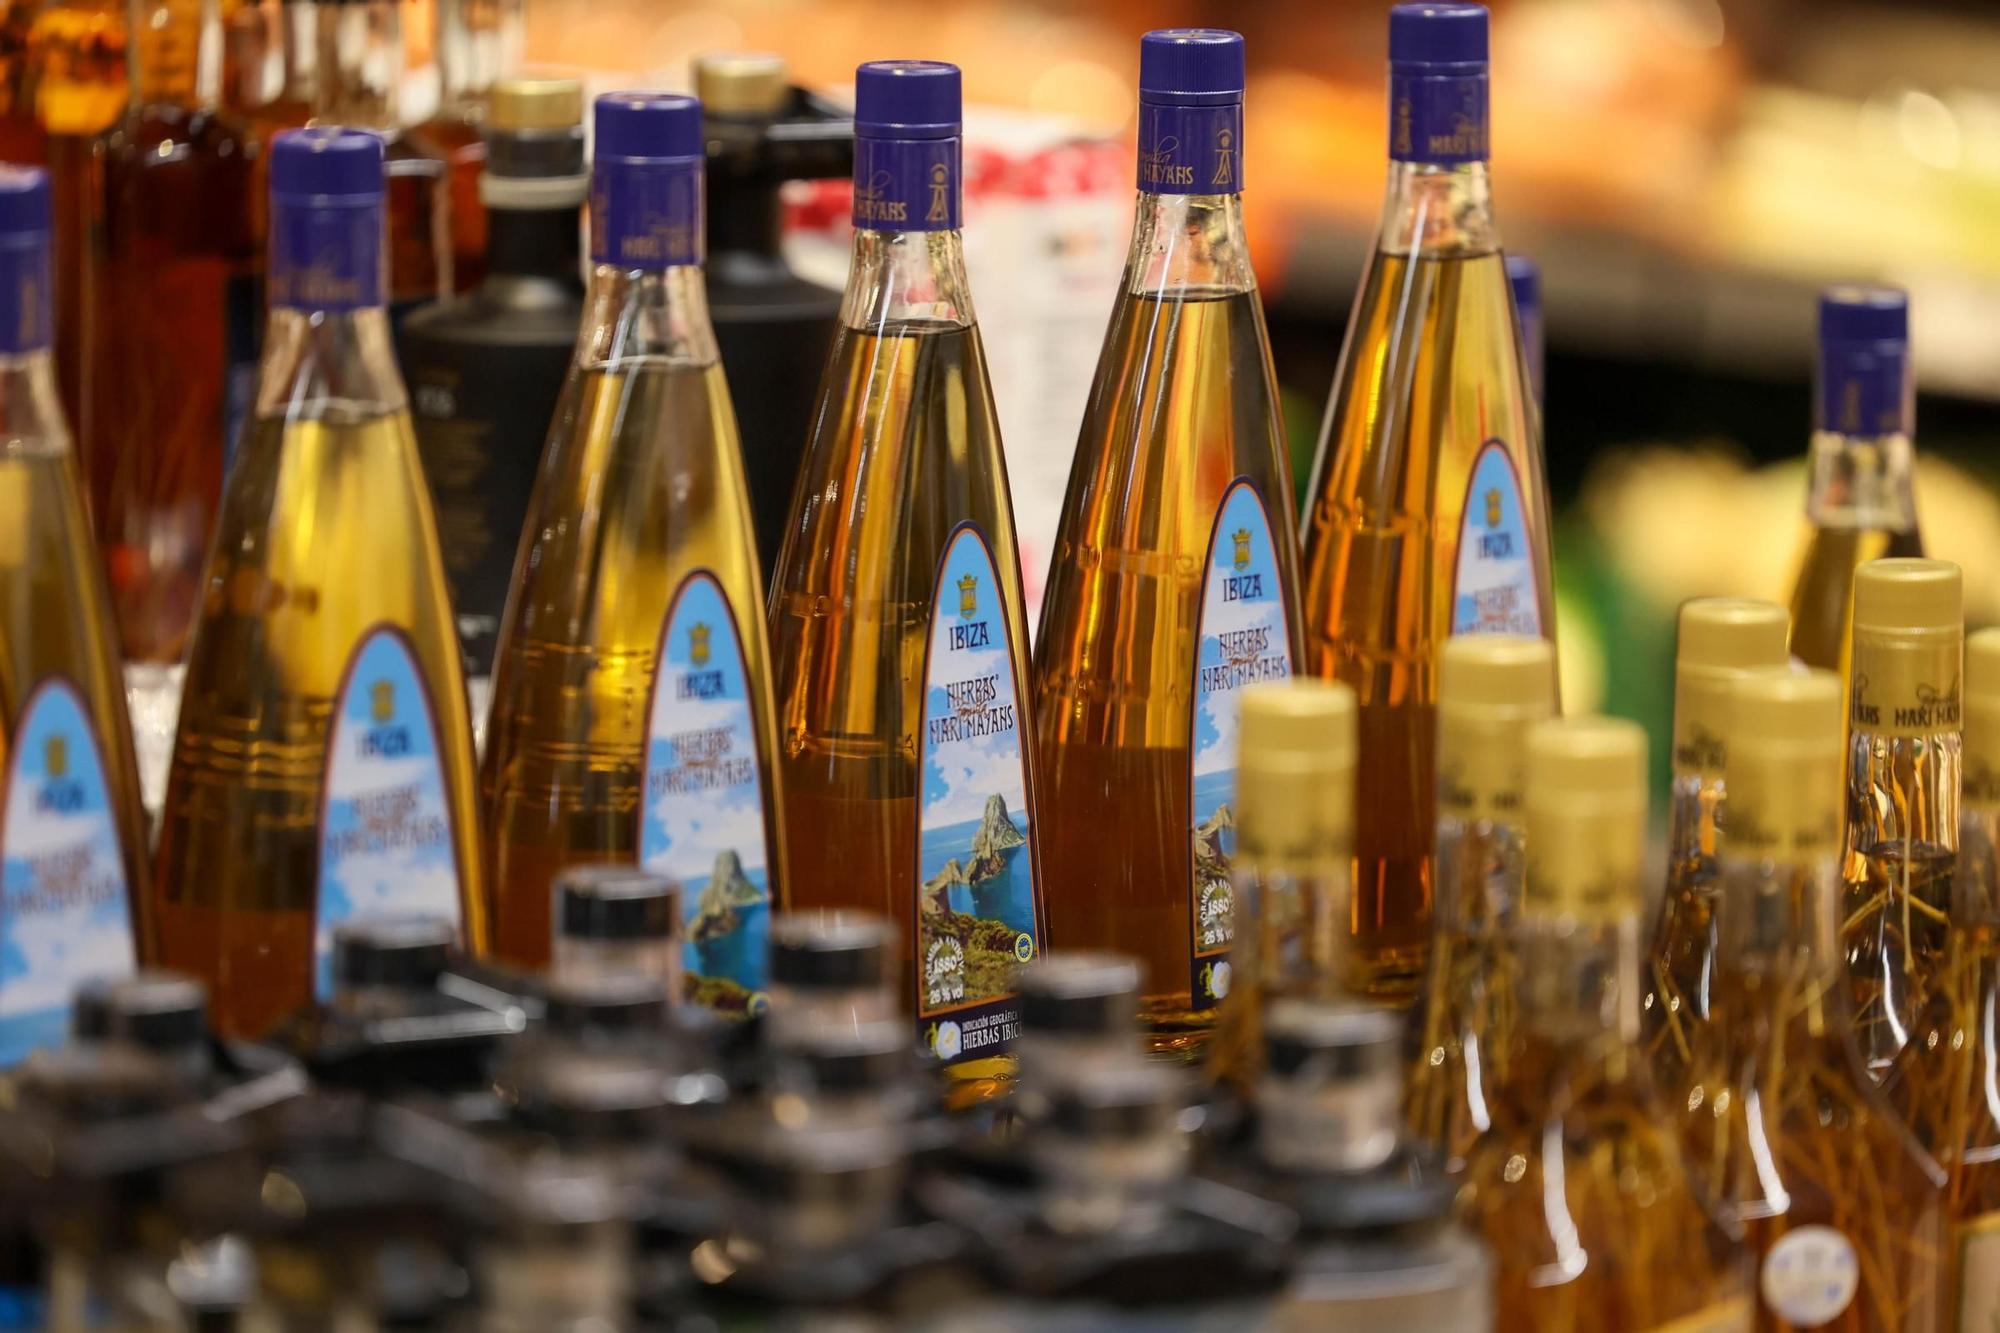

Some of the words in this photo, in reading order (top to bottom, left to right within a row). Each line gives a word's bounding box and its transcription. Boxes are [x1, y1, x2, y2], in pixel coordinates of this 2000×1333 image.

[1222, 574, 1263, 602] IBIZA
[949, 621, 991, 651] IBIZA
[1204, 929, 1217, 945] 26
[929, 988, 942, 1005] 26
[962, 1027, 1000, 1051] HIERBAS
